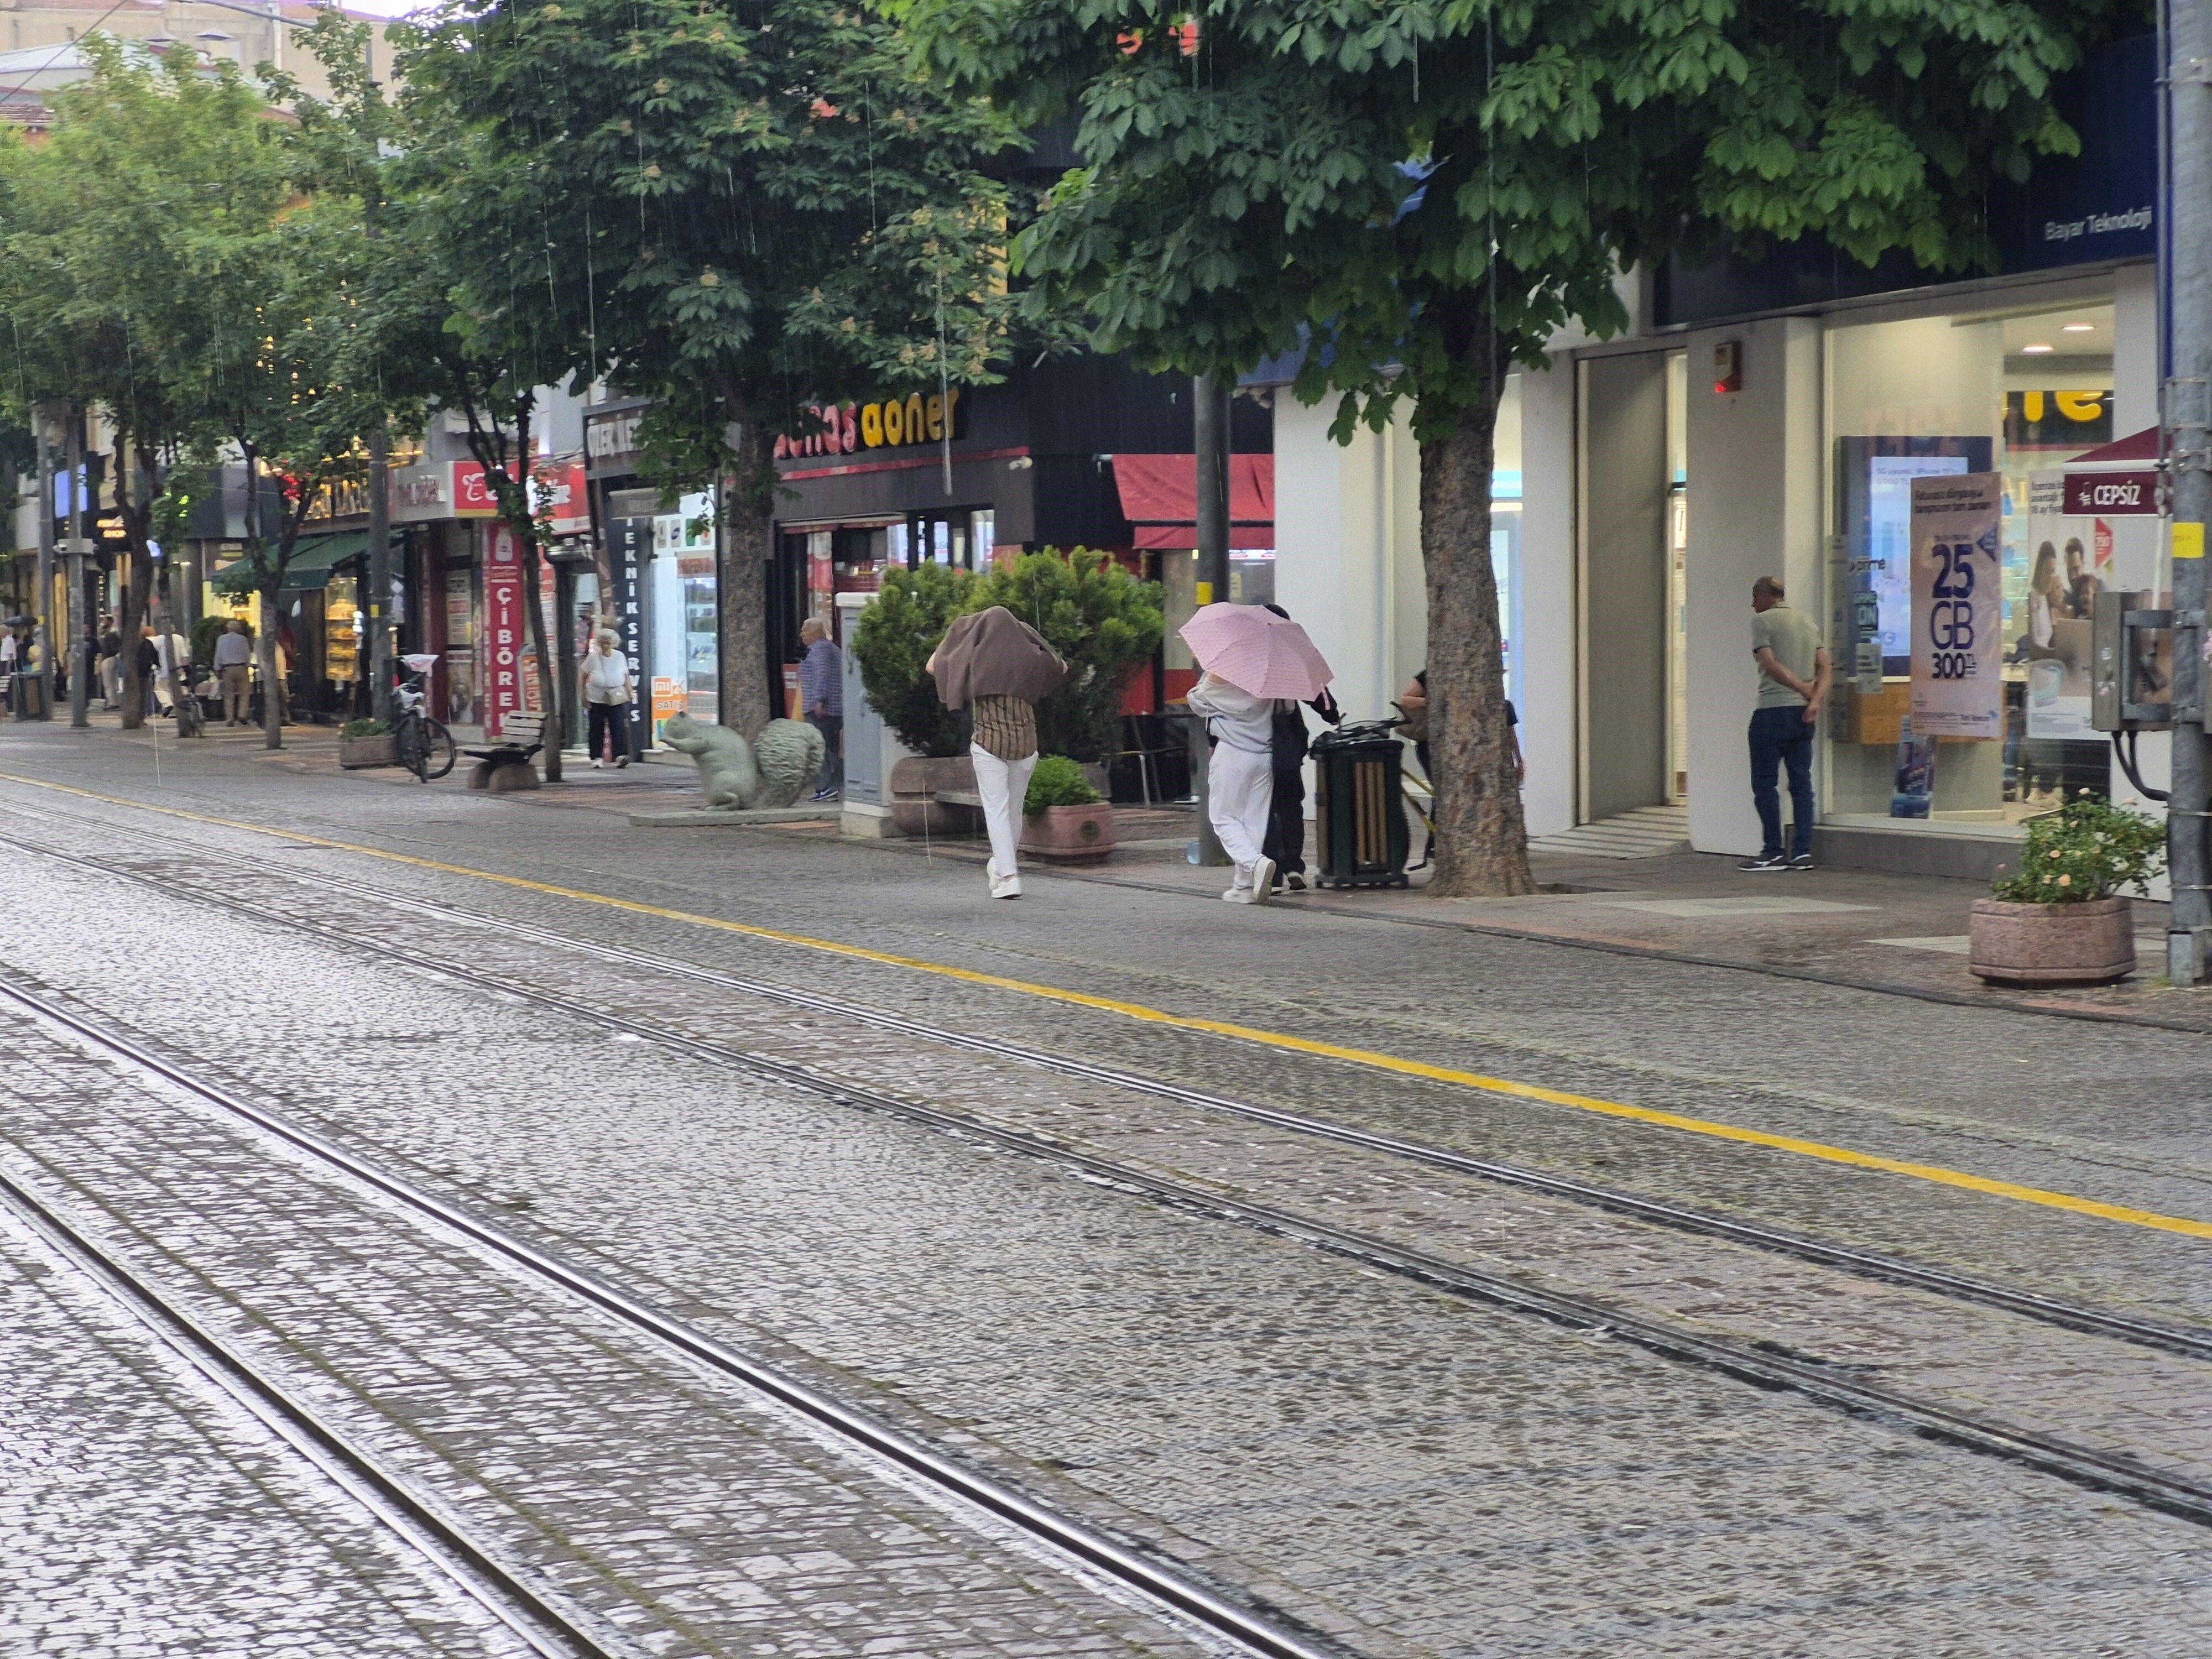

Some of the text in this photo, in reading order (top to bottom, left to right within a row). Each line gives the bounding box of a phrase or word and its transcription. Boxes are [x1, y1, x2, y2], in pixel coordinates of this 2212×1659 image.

[2045, 205, 2152, 242] Bayar Teknoloji
[2094, 479, 2141, 505] CEPSİZ
[1932, 544, 1975, 599] 25
[1931, 600, 1975, 650] GB
[1932, 652, 1965, 679] 300
